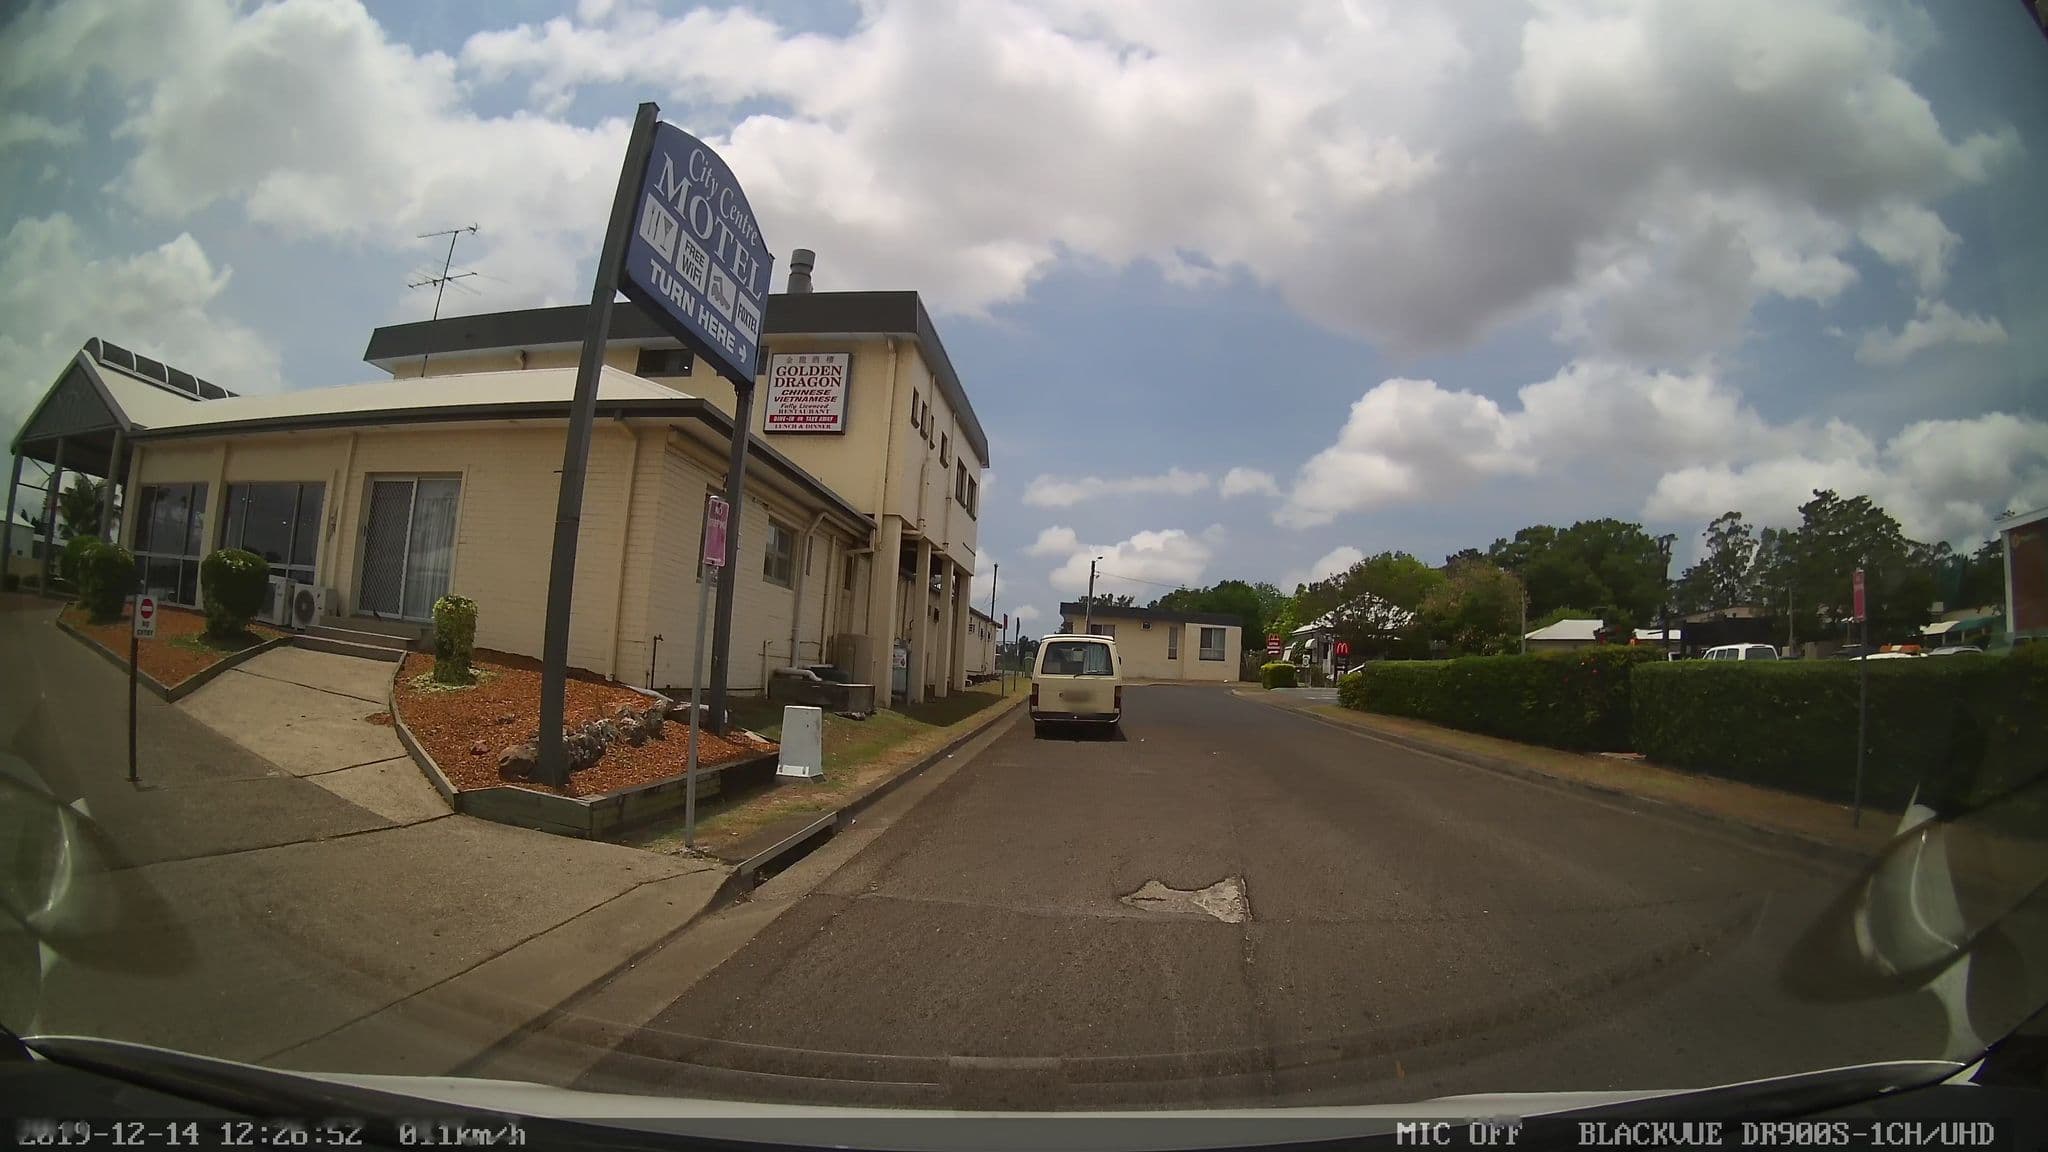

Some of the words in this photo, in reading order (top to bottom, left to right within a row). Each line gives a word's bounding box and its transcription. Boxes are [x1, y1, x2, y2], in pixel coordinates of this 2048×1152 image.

[688, 149, 719, 200] City
[720, 187, 759, 247] Centre
[654, 151, 763, 301] MOTEL
[684, 239, 705, 268] FREE
[650, 258, 696, 318] TURN
[697, 304, 736, 354] HERE
[737, 302, 758, 336] FOXTEL
[774, 376, 842, 388] DRAGON
[776, 365, 842, 377] GOLDEN
